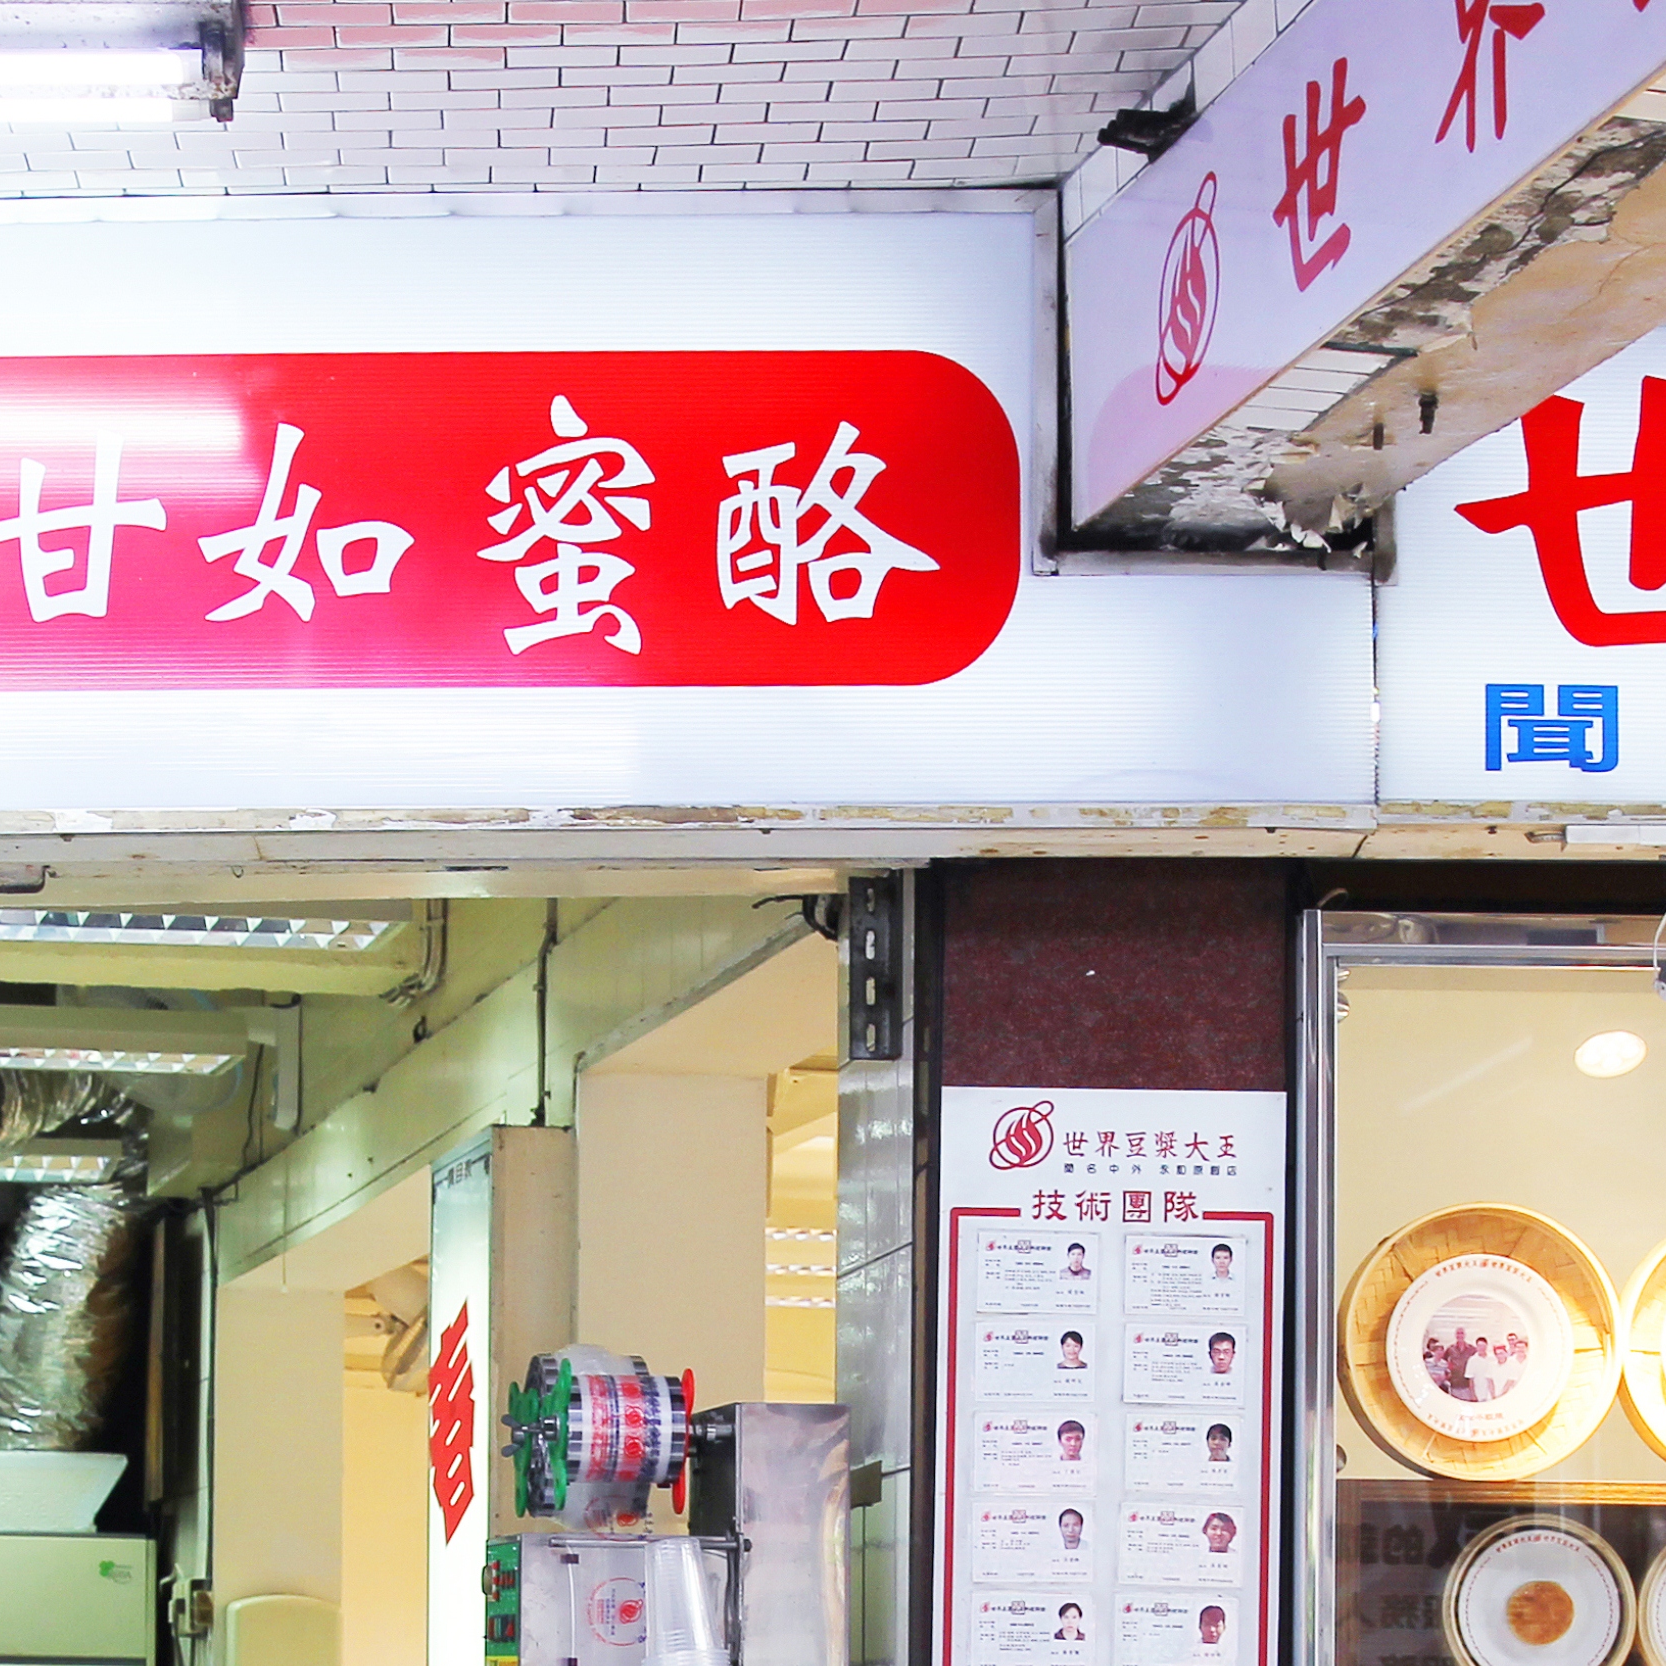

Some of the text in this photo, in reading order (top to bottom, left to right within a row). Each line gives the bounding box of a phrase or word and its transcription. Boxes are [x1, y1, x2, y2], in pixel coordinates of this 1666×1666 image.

[1062, 1130, 1239, 1162] 世界豆漿大王
[1032, 1188, 1199, 1223] 技術團隊
